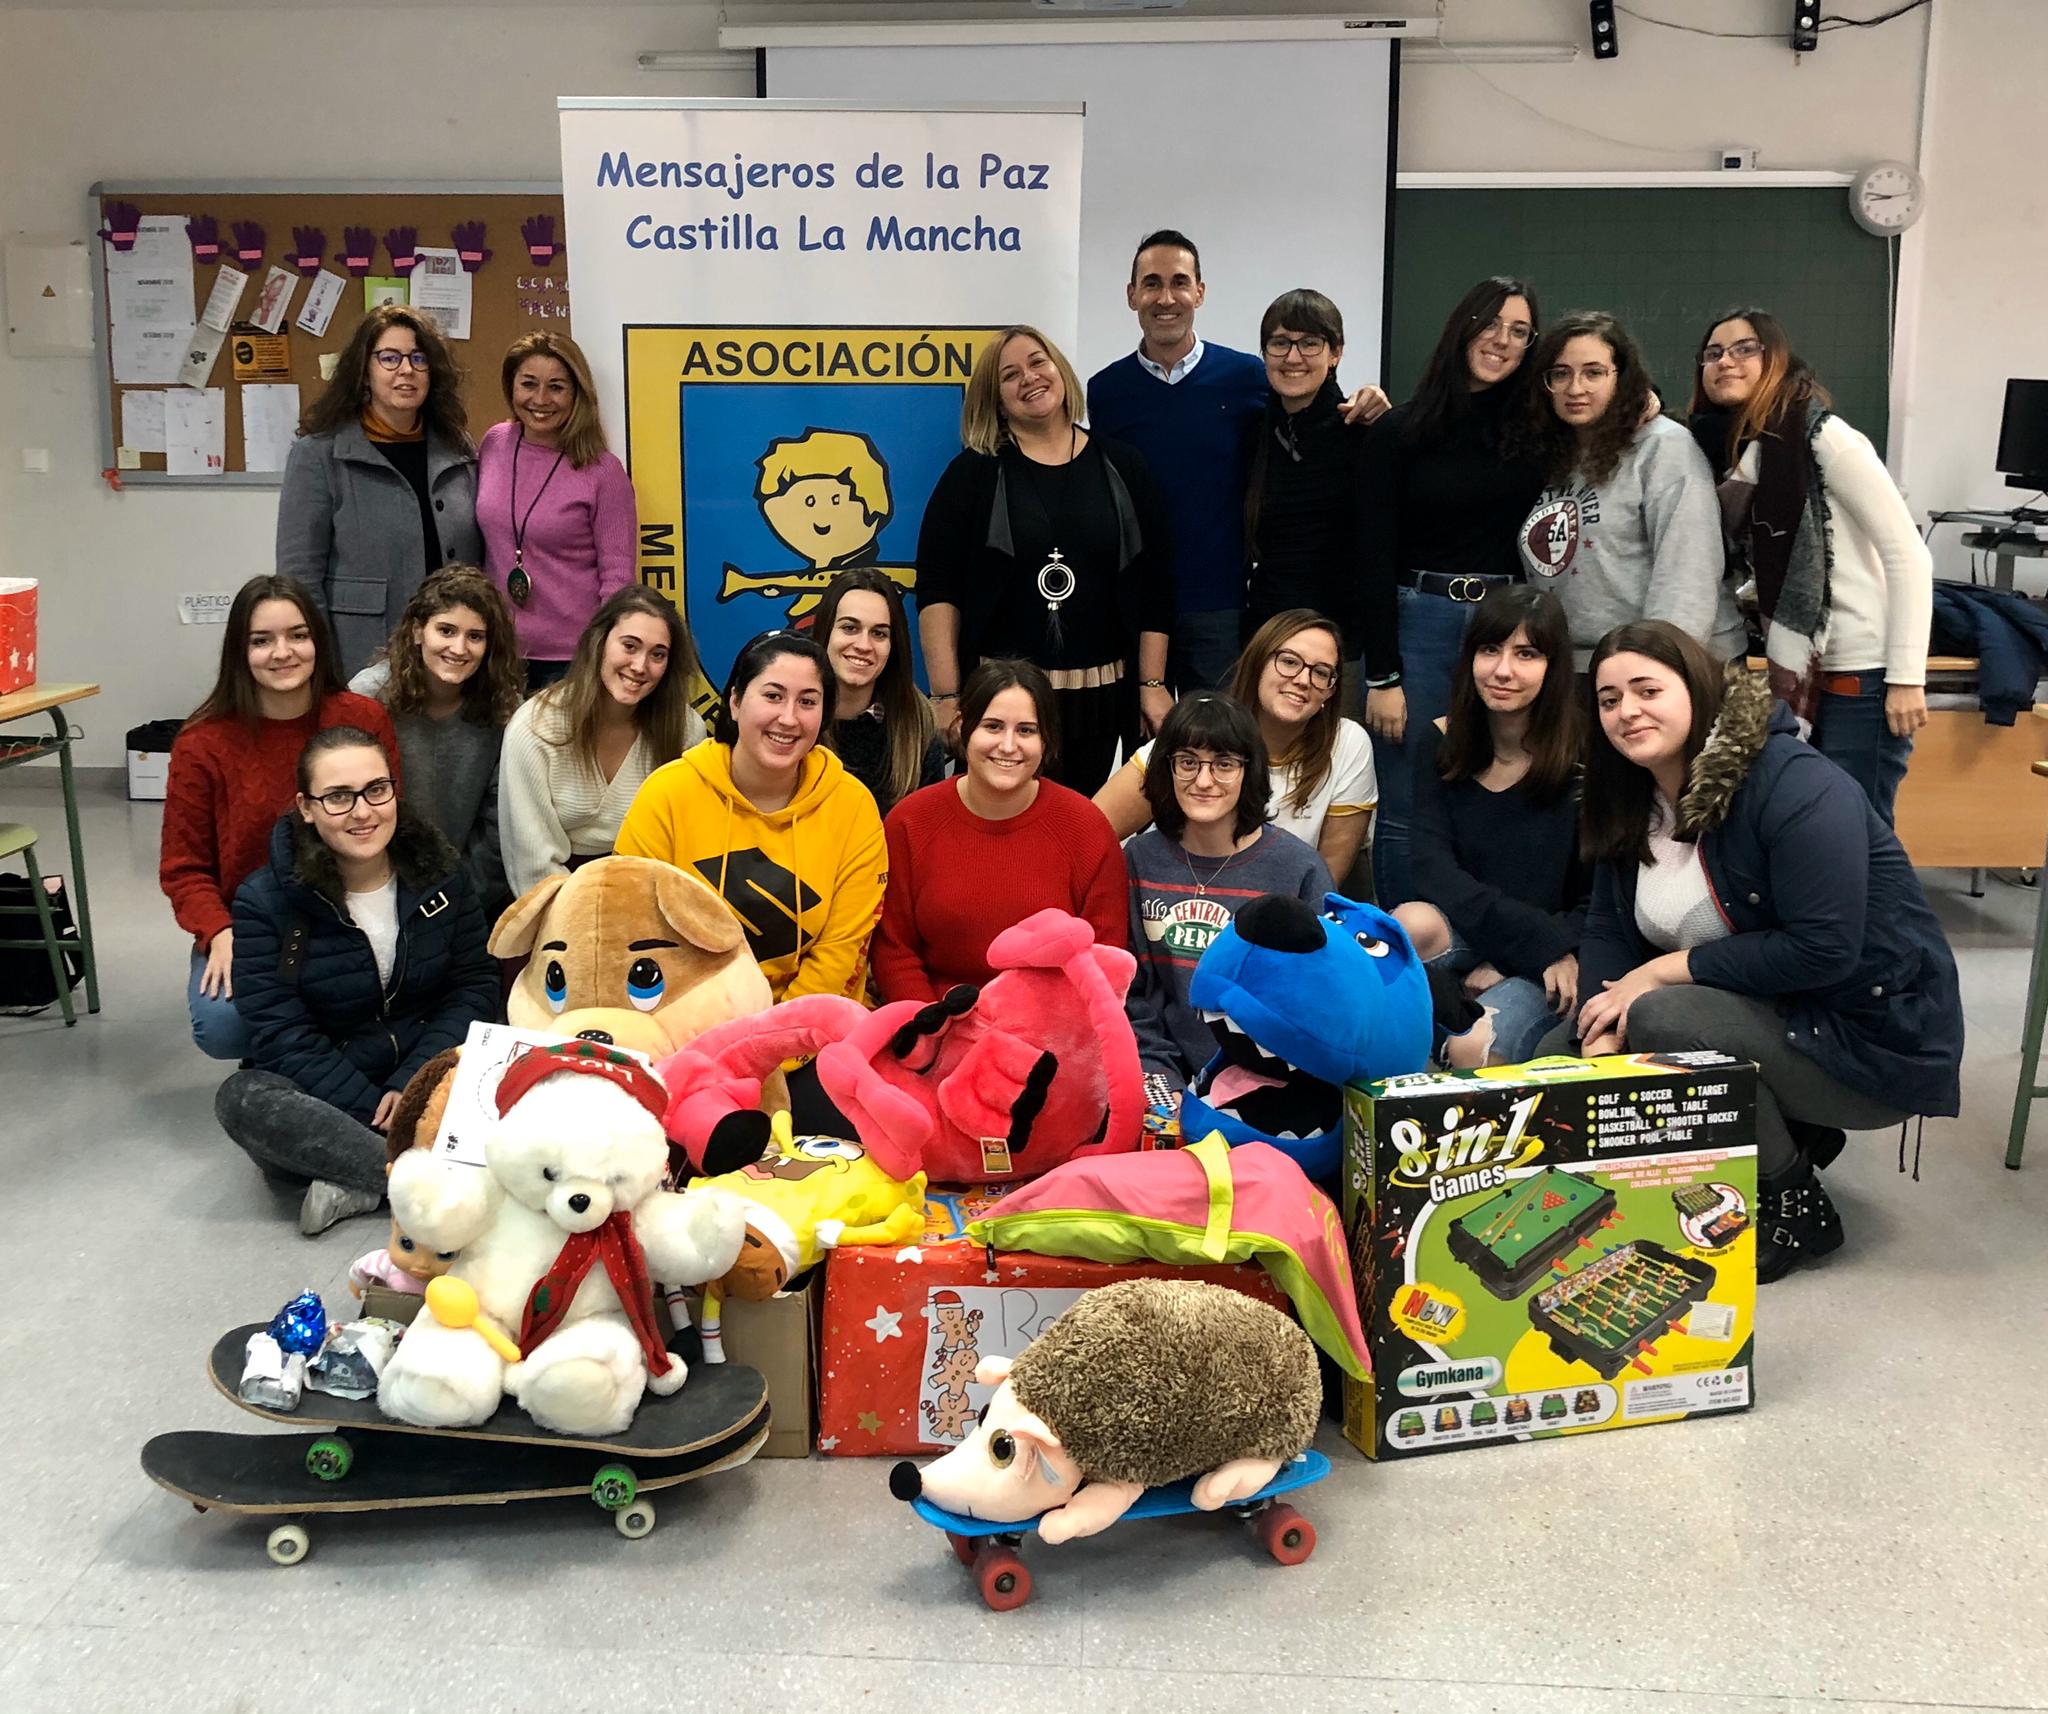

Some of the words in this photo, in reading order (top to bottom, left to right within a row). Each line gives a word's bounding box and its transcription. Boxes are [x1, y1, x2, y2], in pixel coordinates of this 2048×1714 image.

[598, 152, 834, 199] Mensajeros
[856, 152, 903, 188] de
[927, 152, 959, 189] la
[980, 153, 1049, 190] Paz
[626, 213, 778, 250] Castilla
[799, 215, 845, 251] La
[866, 215, 1020, 251] Mancha
[682, 334, 973, 377] ASOCIACIÓN
[640, 524, 675, 608] ME
[1174, 901, 1227, 929] CENTRAL
[1598, 1094, 1620, 1106] GOLF
[1640, 1089, 1673, 1102] SOCCER
[1697, 1084, 1728, 1097] TARGET
[1598, 1107, 1636, 1120] BOWLING
[1655, 1103, 1677, 1115] POOL
[1682, 1100, 1708, 1111] TABLE
[1598, 1120, 1651, 1134] BASKETBALL
[1666, 1115, 1703, 1127] SHOOTER
[1707, 1111, 1738, 1123] HOCKEY
[1598, 1134, 1636, 1148] SNOOKER
[1640, 1132, 1661, 1144] POOL
[1667, 1129, 1693, 1141] TABLE
[1430, 1165, 1506, 1202] Games
[1001, 1289, 1057, 1347] Re
[1402, 1289, 1459, 1328] New
[1416, 1366, 1483, 1388] Gymkana
